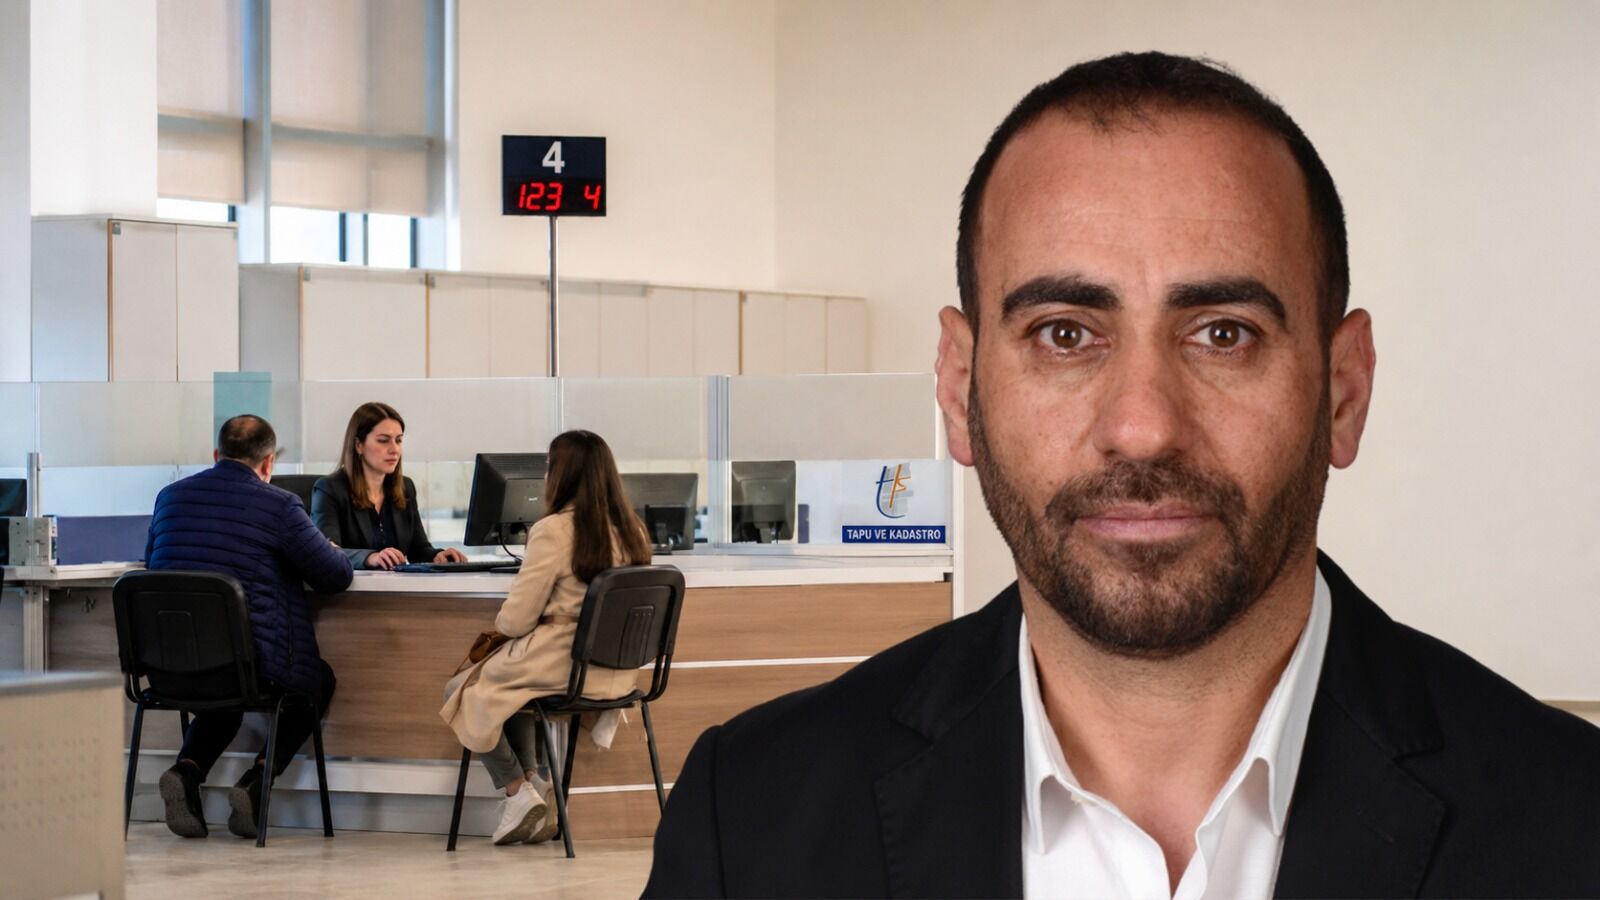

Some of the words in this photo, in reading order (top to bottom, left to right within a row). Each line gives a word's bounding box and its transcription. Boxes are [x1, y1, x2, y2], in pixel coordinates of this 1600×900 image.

[542, 140, 565, 174] 4
[518, 182, 563, 211] 123
[584, 185, 601, 210] 4
[846, 529, 872, 540] TAPU
[874, 529, 887, 540] VE
[889, 529, 941, 540] KADASTRO
